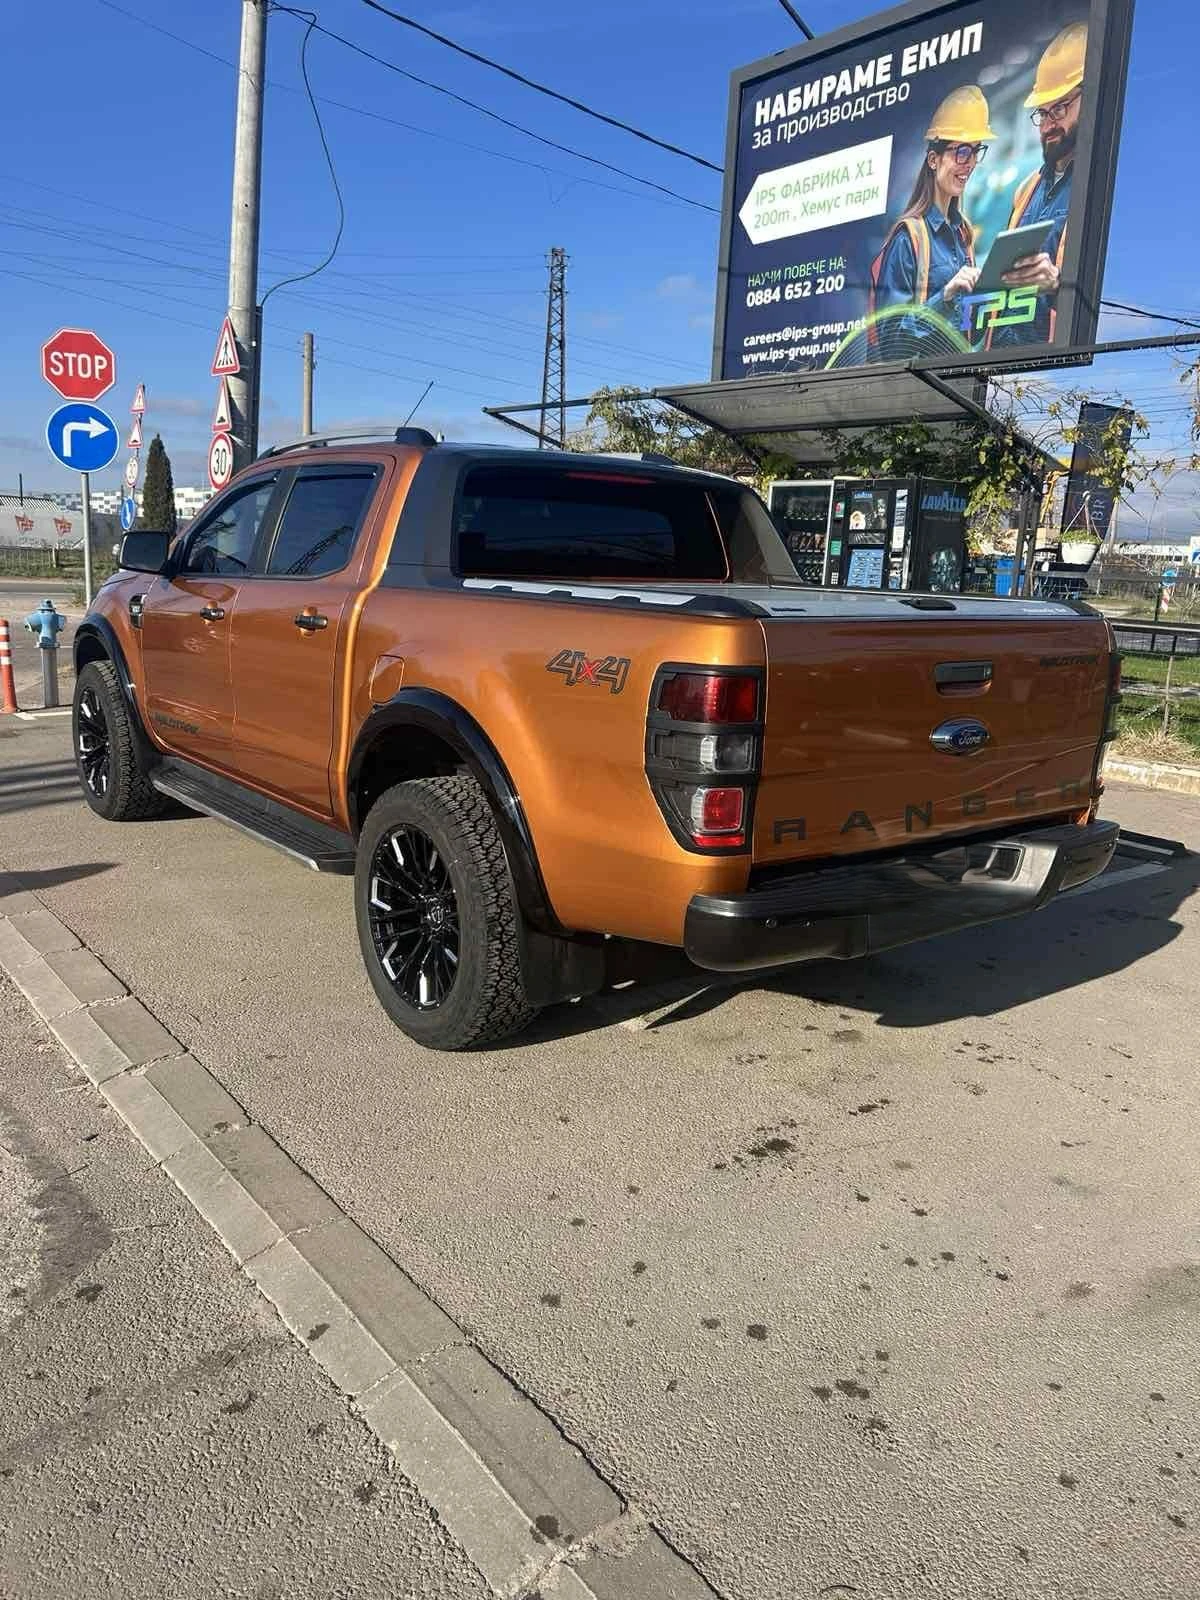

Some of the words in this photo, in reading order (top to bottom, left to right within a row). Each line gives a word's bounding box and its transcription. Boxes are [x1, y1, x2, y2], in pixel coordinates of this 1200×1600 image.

[754, 54, 893, 127] НАБИРАМЕ
[901, 22, 984, 77] ЕКИП
[752, 128, 772, 149] за
[756, 186, 776, 207] IPS
[781, 165, 850, 199] ФАБРИКА
[801, 195, 841, 217] Хемус
[845, 186, 880, 207] парк
[748, 269, 781, 287] НАУЧИ
[784, 259, 826, 280] ПОВЕЧЕ
[829, 256, 847, 271] НА:
[746, 286, 781, 307] 0884
[784, 281, 812, 300] 652
[815, 274, 845, 295] 200
[743, 316, 866, 347] careers@ips-group.net
[50, 351, 108, 380] STOP
[742, 338, 841, 364] www.ips-group.net
[213, 448, 227, 476] 30
[545, 649, 631, 694] 4x4
[959, 729, 982, 745] Ford
[772, 779, 1082, 845] RANGER
